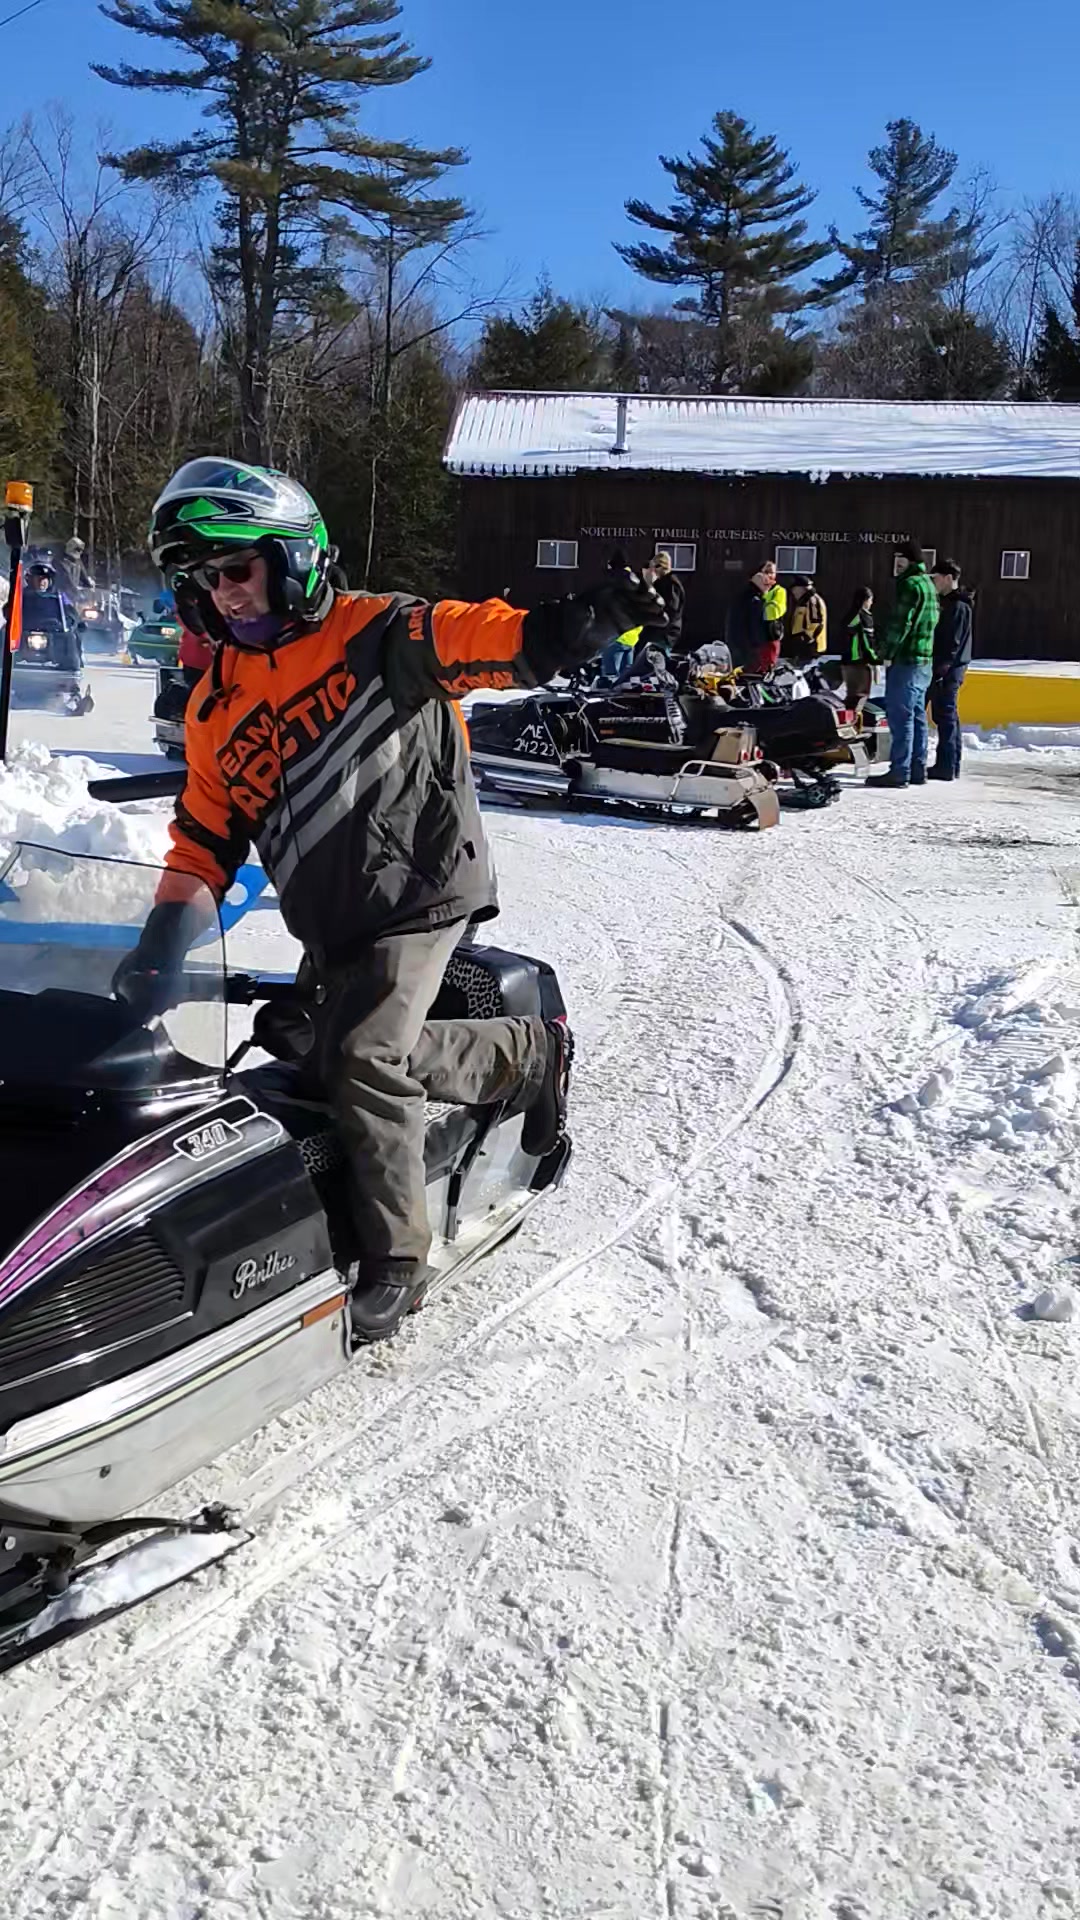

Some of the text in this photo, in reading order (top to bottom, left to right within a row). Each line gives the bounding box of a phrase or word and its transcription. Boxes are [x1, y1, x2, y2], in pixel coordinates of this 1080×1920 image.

[580, 527, 911, 544] NORTHERN TIMBER CRUISERS SNOWMOBILE MUSEUM
[521, 724, 544, 739] ME
[221, 713, 274, 778] EAM
[513, 738, 555, 757] 24223
[188, 1123, 226, 1156] 340
[231, 1251, 296, 1299] Panther
